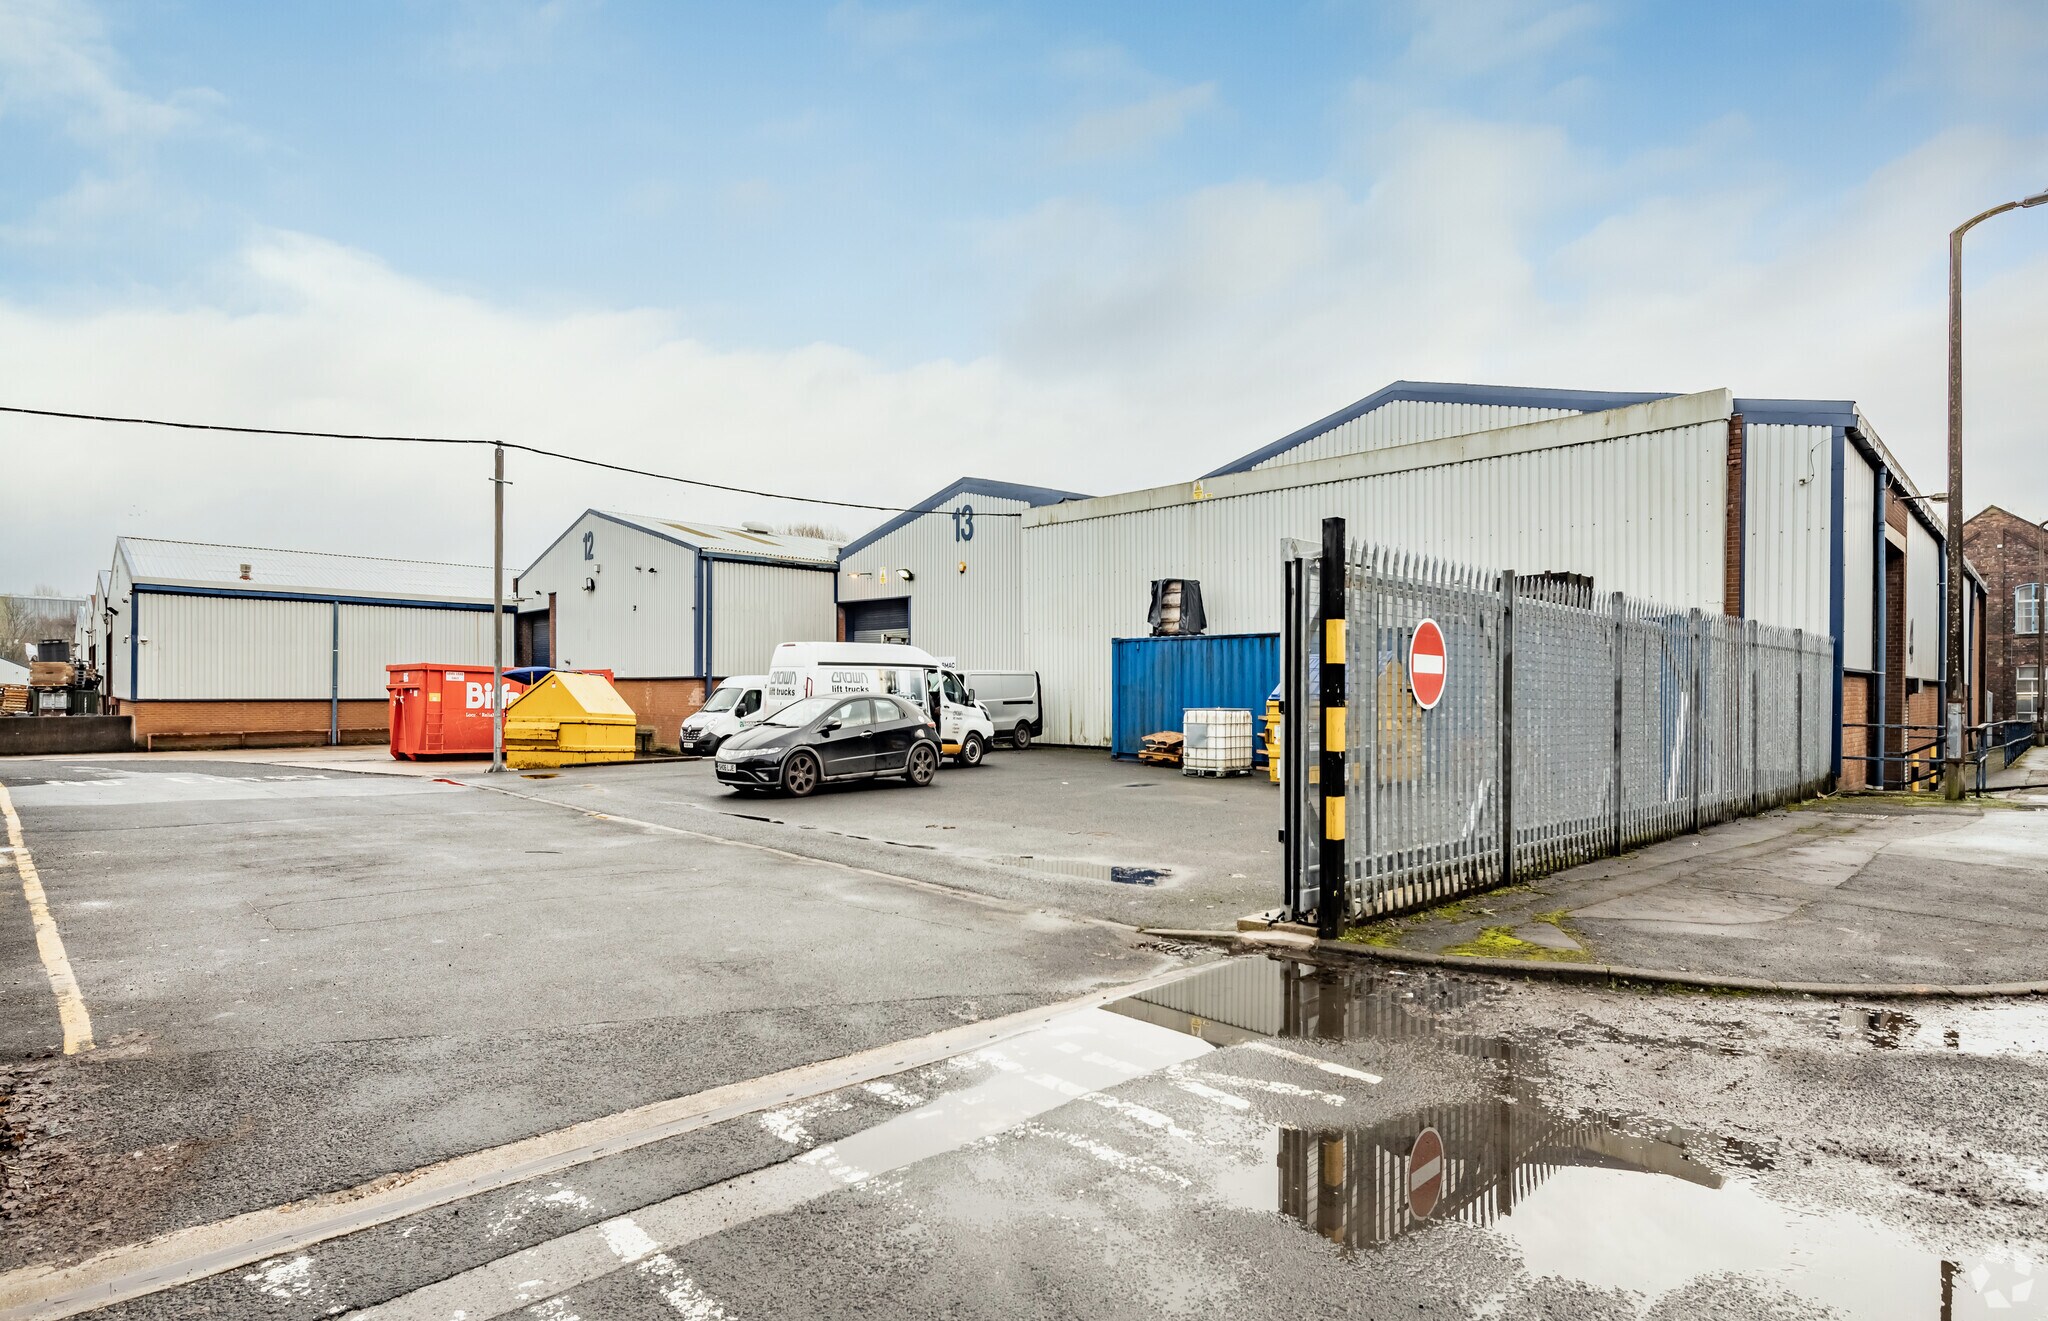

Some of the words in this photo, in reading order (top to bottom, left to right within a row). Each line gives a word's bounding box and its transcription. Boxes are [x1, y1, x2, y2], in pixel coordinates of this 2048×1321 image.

[952, 504, 974, 542] 13
[582, 530, 594, 561] 12
[466, 682, 520, 709] Bif
[776, 688, 796, 697] trucks
[832, 685, 843, 693] lift
[845, 685, 870, 693] trucks
